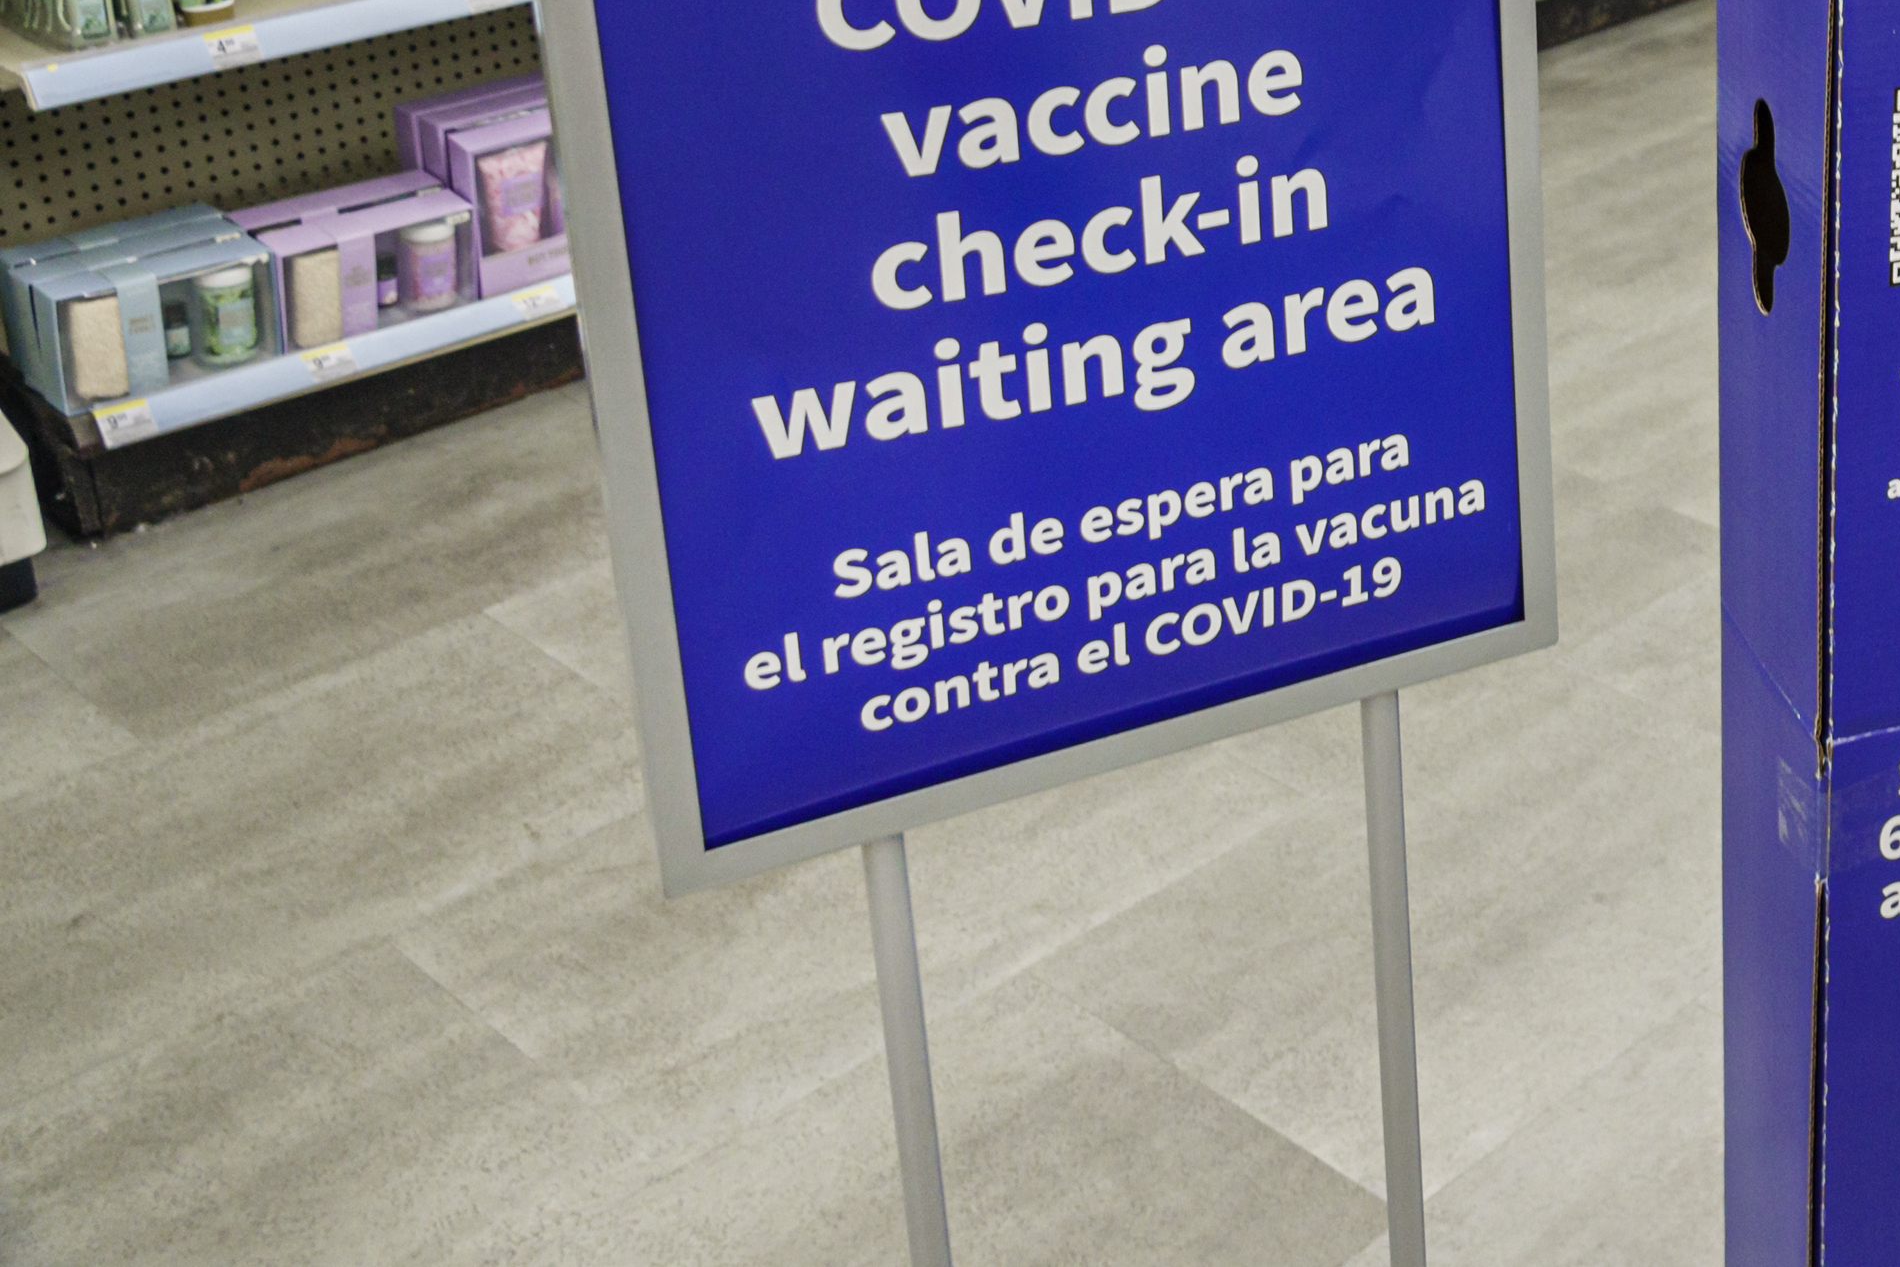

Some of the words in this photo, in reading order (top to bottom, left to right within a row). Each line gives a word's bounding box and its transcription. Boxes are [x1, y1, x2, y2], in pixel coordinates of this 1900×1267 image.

[881, 44, 1303, 177] vaccine
[871, 155, 1328, 310] check-in
[751, 318, 1195, 459] waiting
[1222, 267, 1435, 369] area
[744, 632, 807, 690] el
[822, 585, 1070, 685] registro
[1087, 548, 1216, 621] para
[1232, 527, 1281, 573] la
[1295, 479, 1485, 556] vacuna
[833, 531, 971, 598] Sala
[988, 512, 1064, 565] de
[1080, 467, 1274, 543] espera
[1290, 434, 1409, 505] para
[861, 652, 1060, 731] contra
[1077, 622, 1131, 674] el
[1145, 557, 1402, 655] COVID-19
